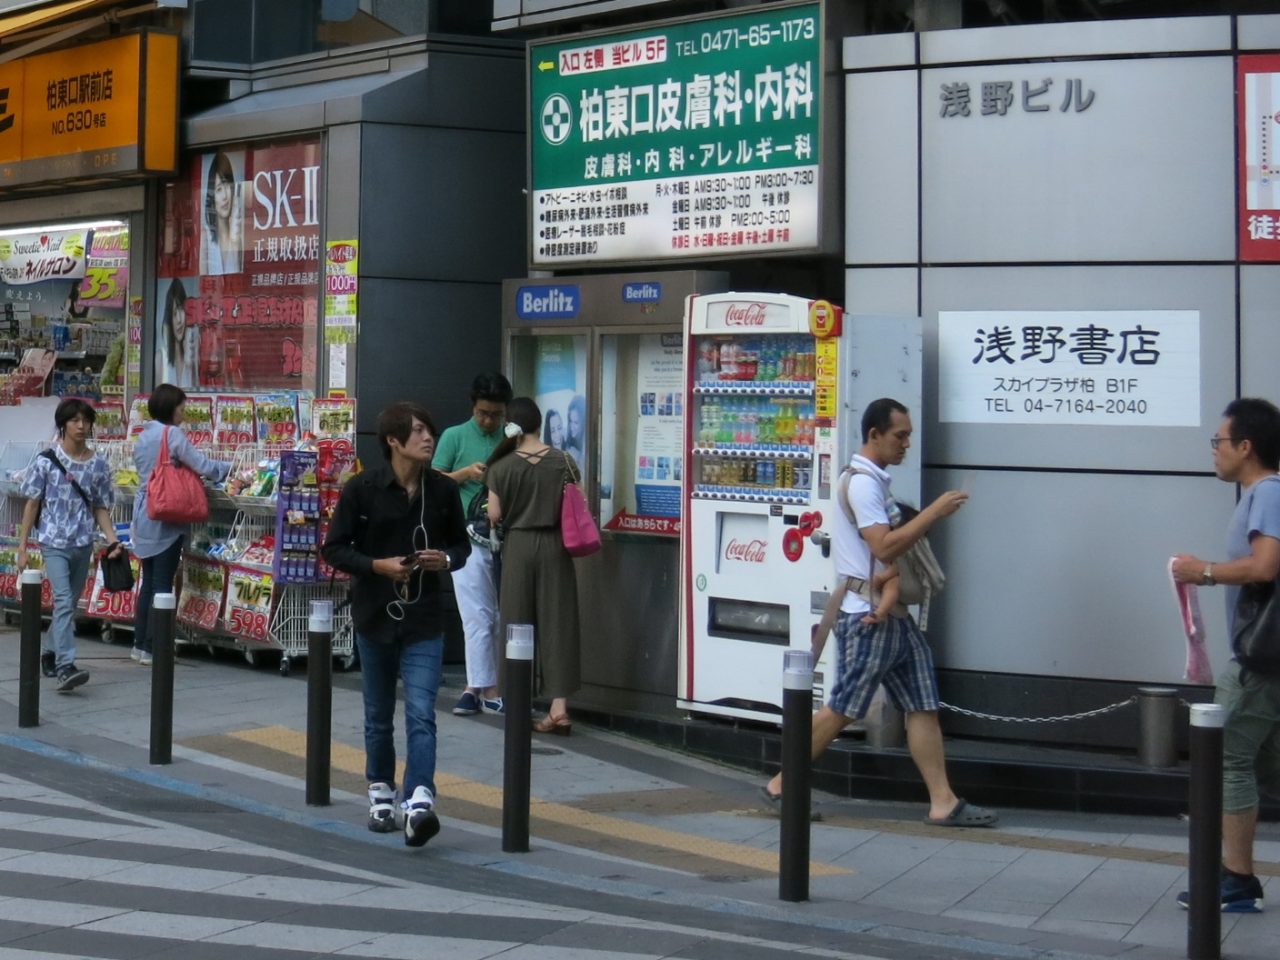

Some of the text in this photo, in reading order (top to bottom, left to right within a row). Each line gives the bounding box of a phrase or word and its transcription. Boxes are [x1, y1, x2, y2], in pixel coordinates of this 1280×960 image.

[676, 17, 815, 58] TEL 0471-65-1173
[561, 38, 666, 73] 入口 左側 当ビル 5F
[46, 69, 113, 112] 柏東口駅前店
[579, 60, 814, 143] 柏東口皮膚科・内科
[938, 77, 1097, 119] 浅野ビル
[51, 109, 107, 136] NO.630号店
[672, 198, 690, 214] 金曜日
[672, 216, 690, 231] 土曜日
[13, 240, 41, 256] Sweetie
[252, 234, 319, 263] 正規取扱店
[25, 256, 78, 279] ネイルサロン
[80, 267, 118, 300] 35
[626, 284, 658, 300] Berlitz
[522, 288, 574, 314] Berlitz
[971, 324, 1161, 366] 浅野書店
[992, 376, 1139, 394] スカイプラザ柏 B1F
[984, 398, 1148, 415] TEL 04-7164-2040
[95, 589, 135, 618] 508
[229, 606, 270, 641] 598
